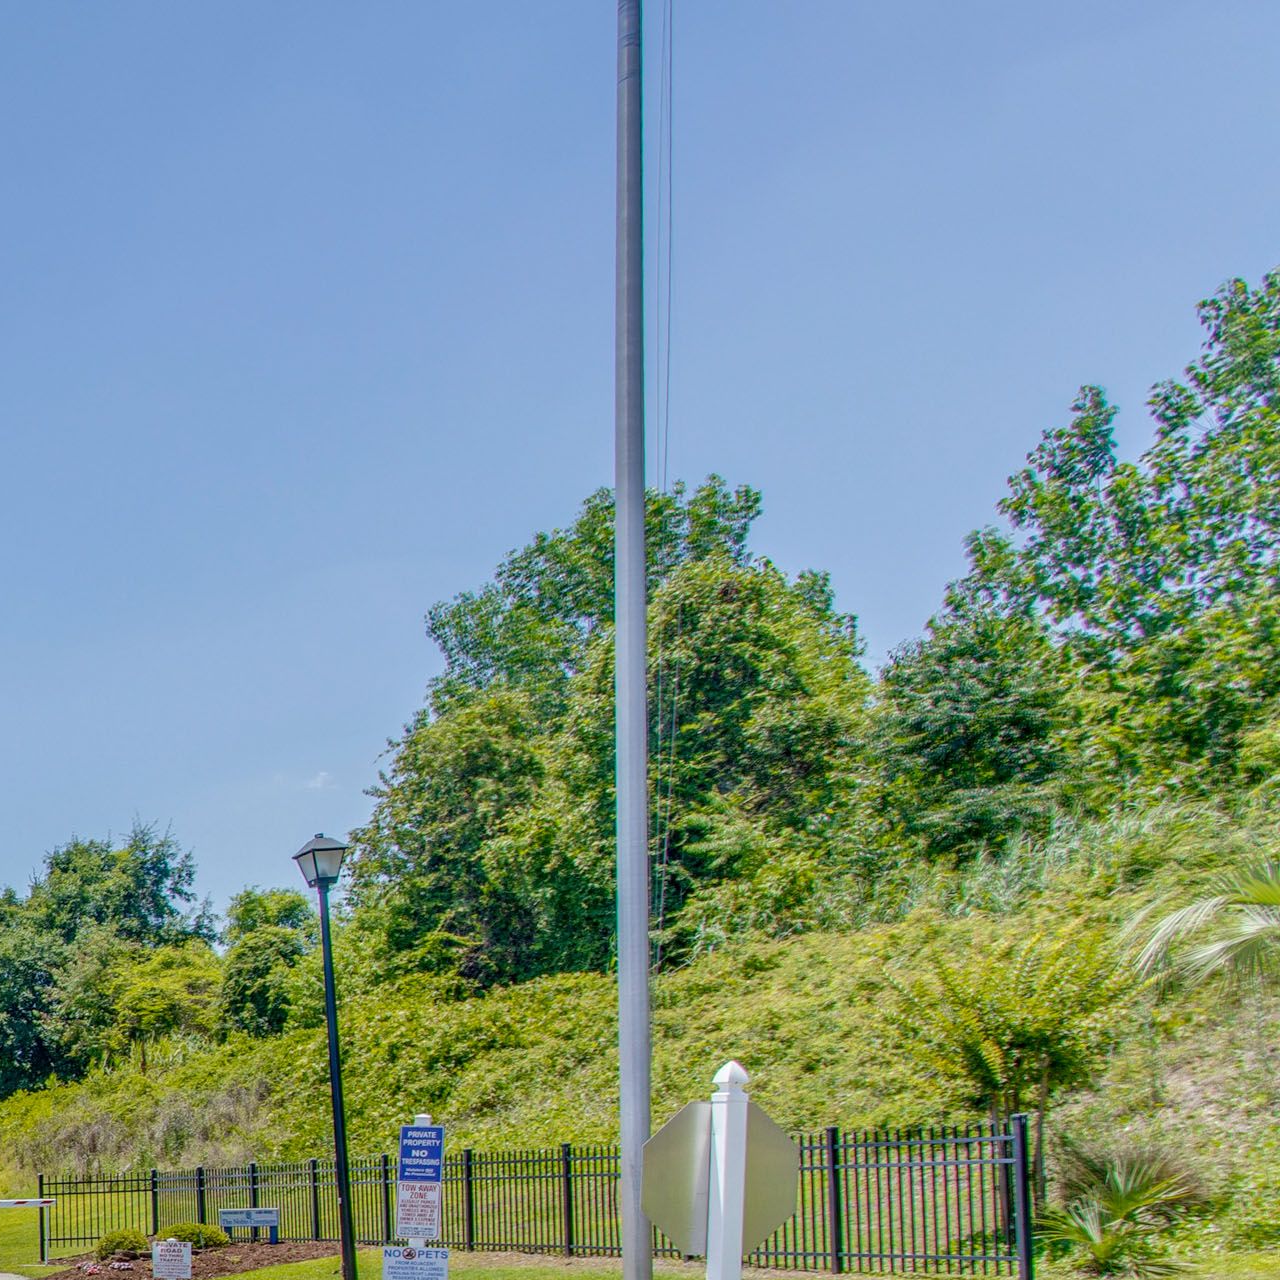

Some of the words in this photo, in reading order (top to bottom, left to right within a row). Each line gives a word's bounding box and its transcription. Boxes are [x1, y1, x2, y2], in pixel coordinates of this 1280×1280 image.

[411, 1149, 428, 1157] NO
[402, 1158, 440, 1166] TRESPASSING
[418, 1250, 448, 1259] PETS
